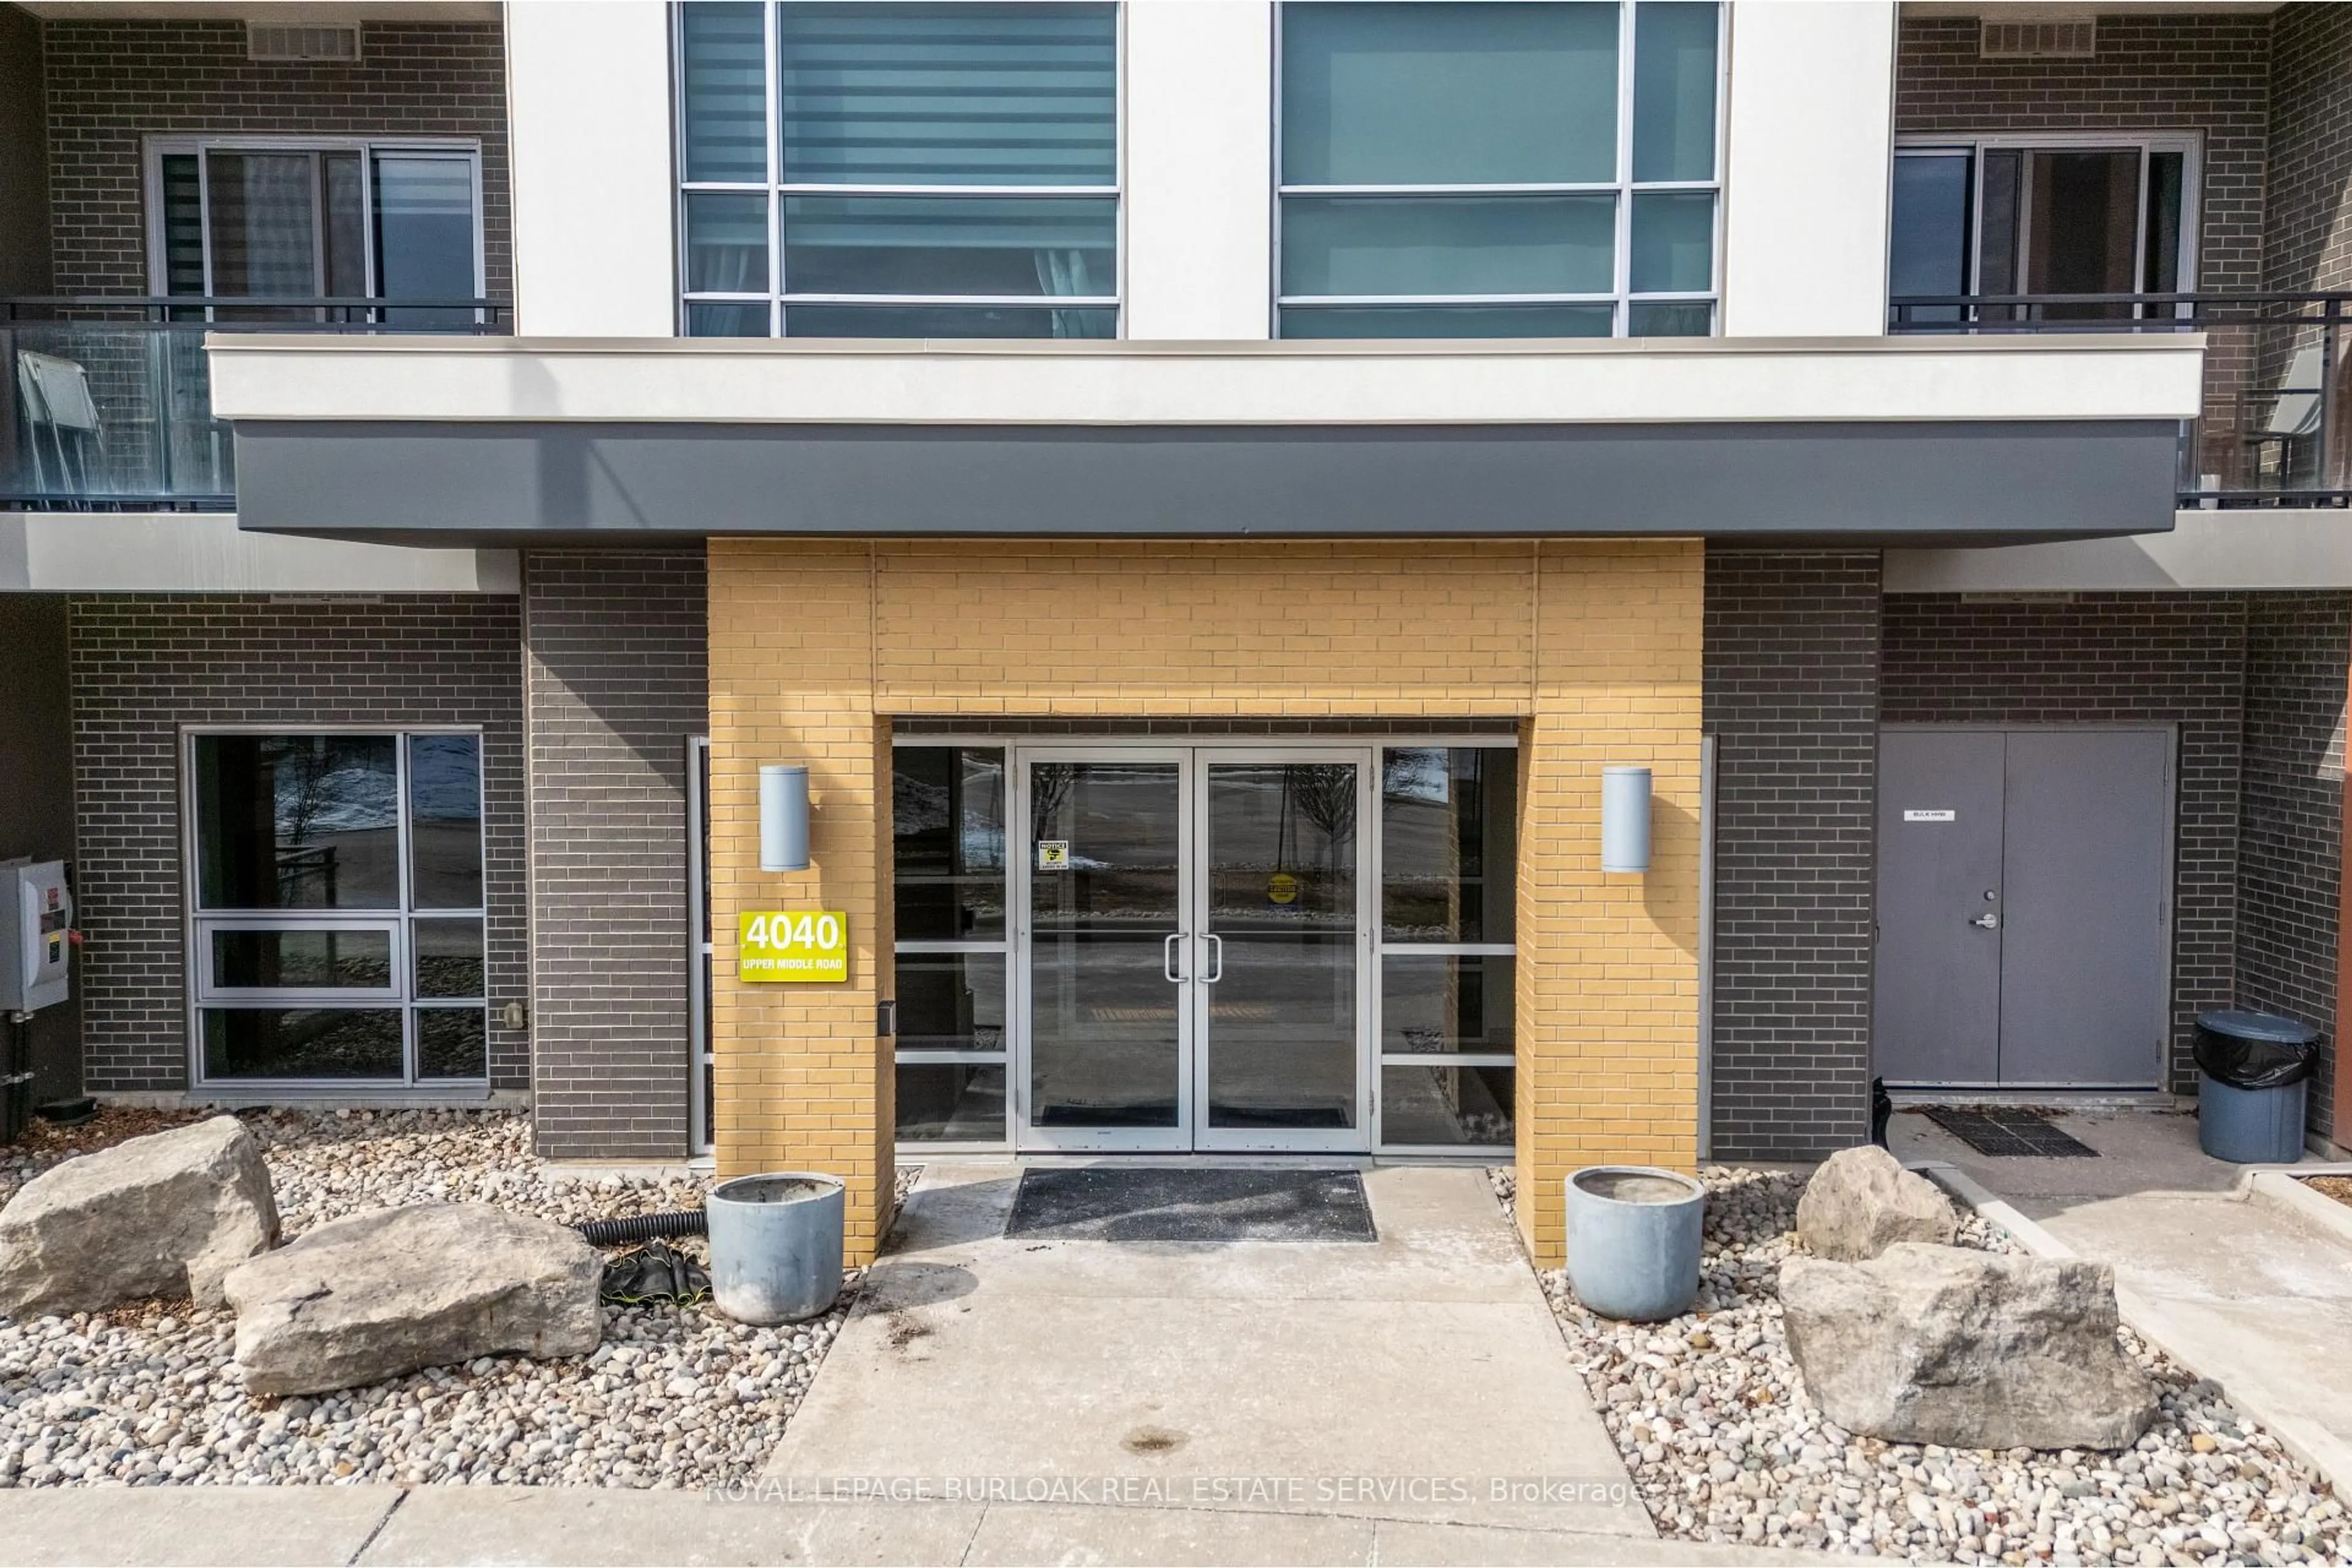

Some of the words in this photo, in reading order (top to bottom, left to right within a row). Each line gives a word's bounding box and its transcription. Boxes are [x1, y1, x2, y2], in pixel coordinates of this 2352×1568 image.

[747, 915, 839, 949] 4040
[743, 959, 775, 969] UPPER
[777, 959, 813, 969] MIDDLE
[816, 959, 843, 969] ROAD
